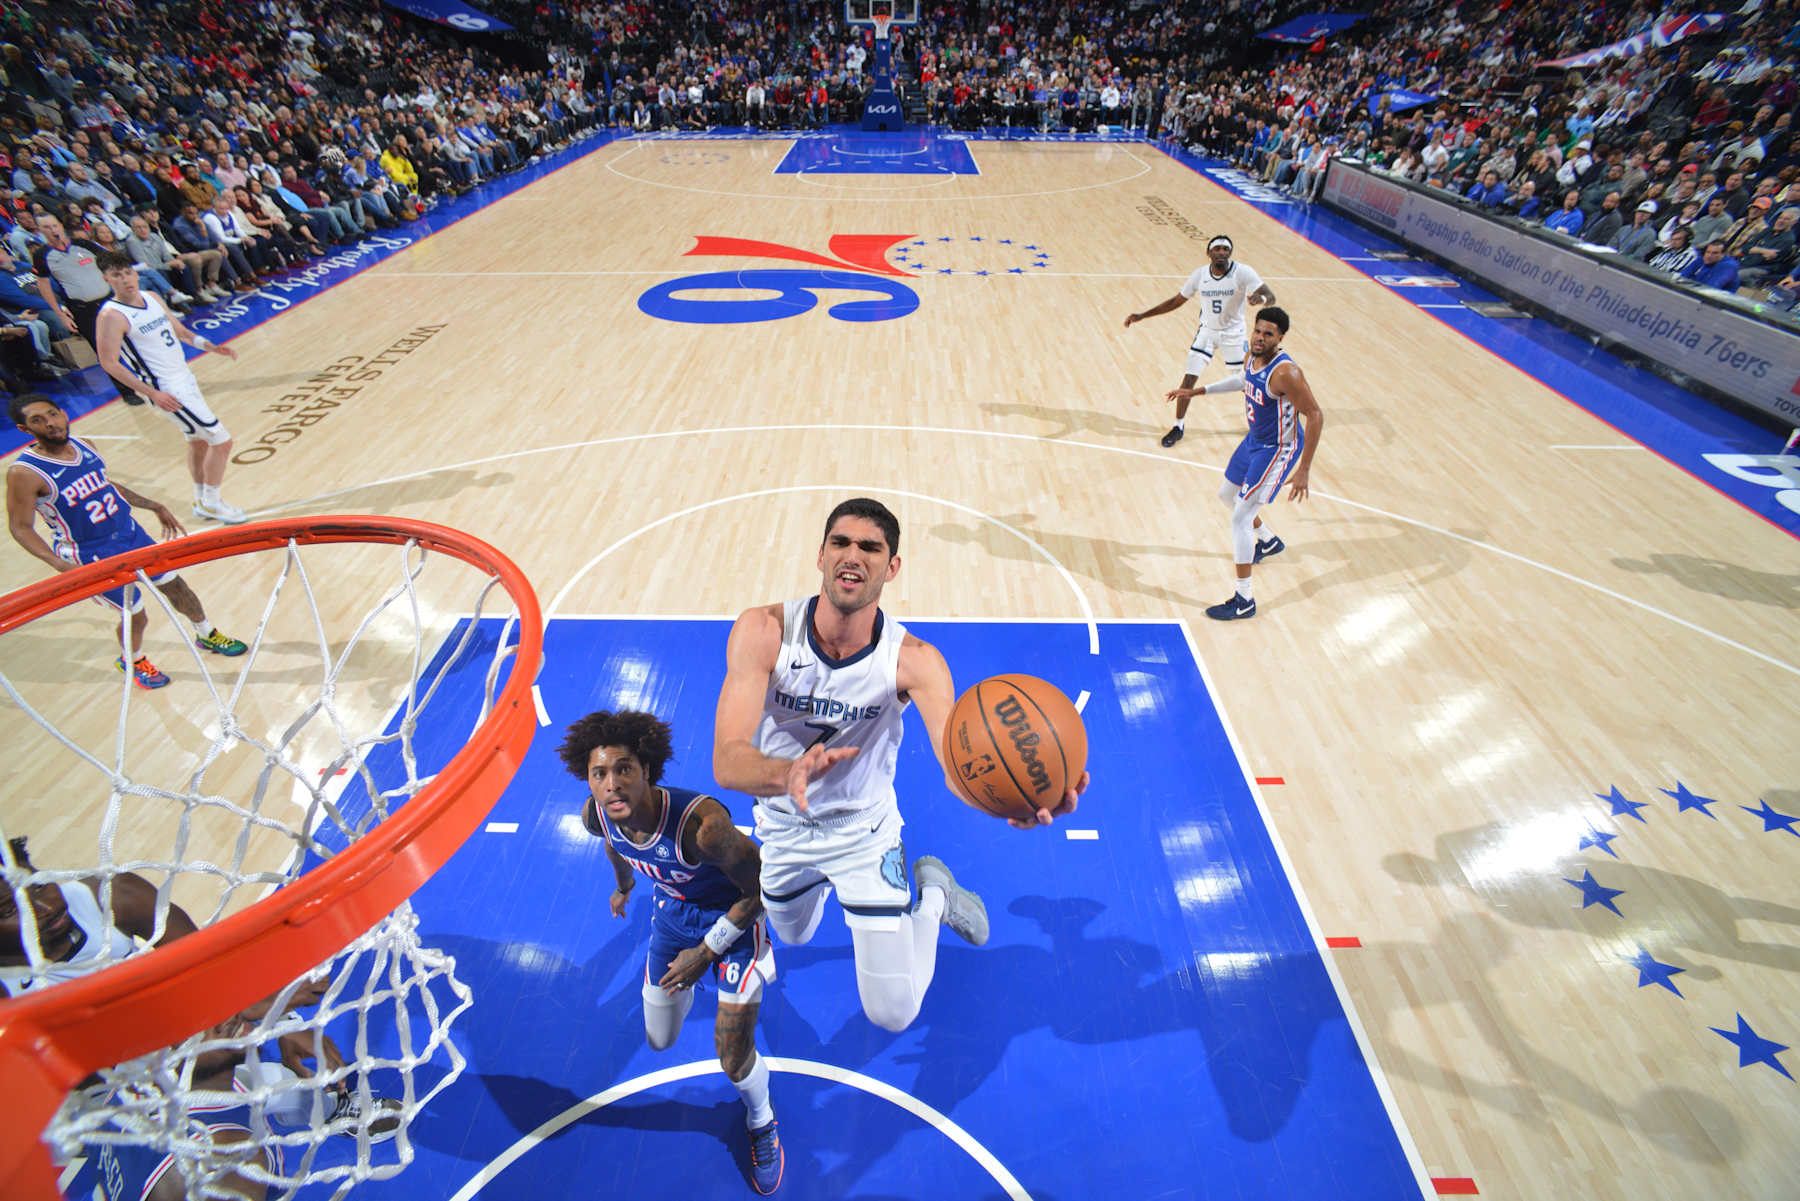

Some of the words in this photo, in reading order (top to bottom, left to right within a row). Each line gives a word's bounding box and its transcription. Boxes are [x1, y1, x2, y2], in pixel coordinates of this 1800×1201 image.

[868, 104, 897, 114] KIA
[1212, 299, 1223, 315] 5
[1415, 212, 1459, 244] Flagship
[1459, 231, 1492, 257] Radio
[1493, 243, 1540, 280] Station
[1541, 269, 1559, 286] of
[1559, 275, 1585, 298] the
[1585, 286, 1702, 349] Philadelphia
[1703, 334, 1773, 379] 76ers
[161, 329, 176, 348] 3
[346, 322, 449, 382] WELLS
[261, 355, 365, 414] CENTER
[231, 385, 366, 466] FARGO
[85, 492, 119, 525] 22
[774, 689, 881, 722] MEMPHIS
[804, 721, 839, 754] 7
[994, 693, 1052, 795] Wilson
[719, 961, 741, 985] 76
